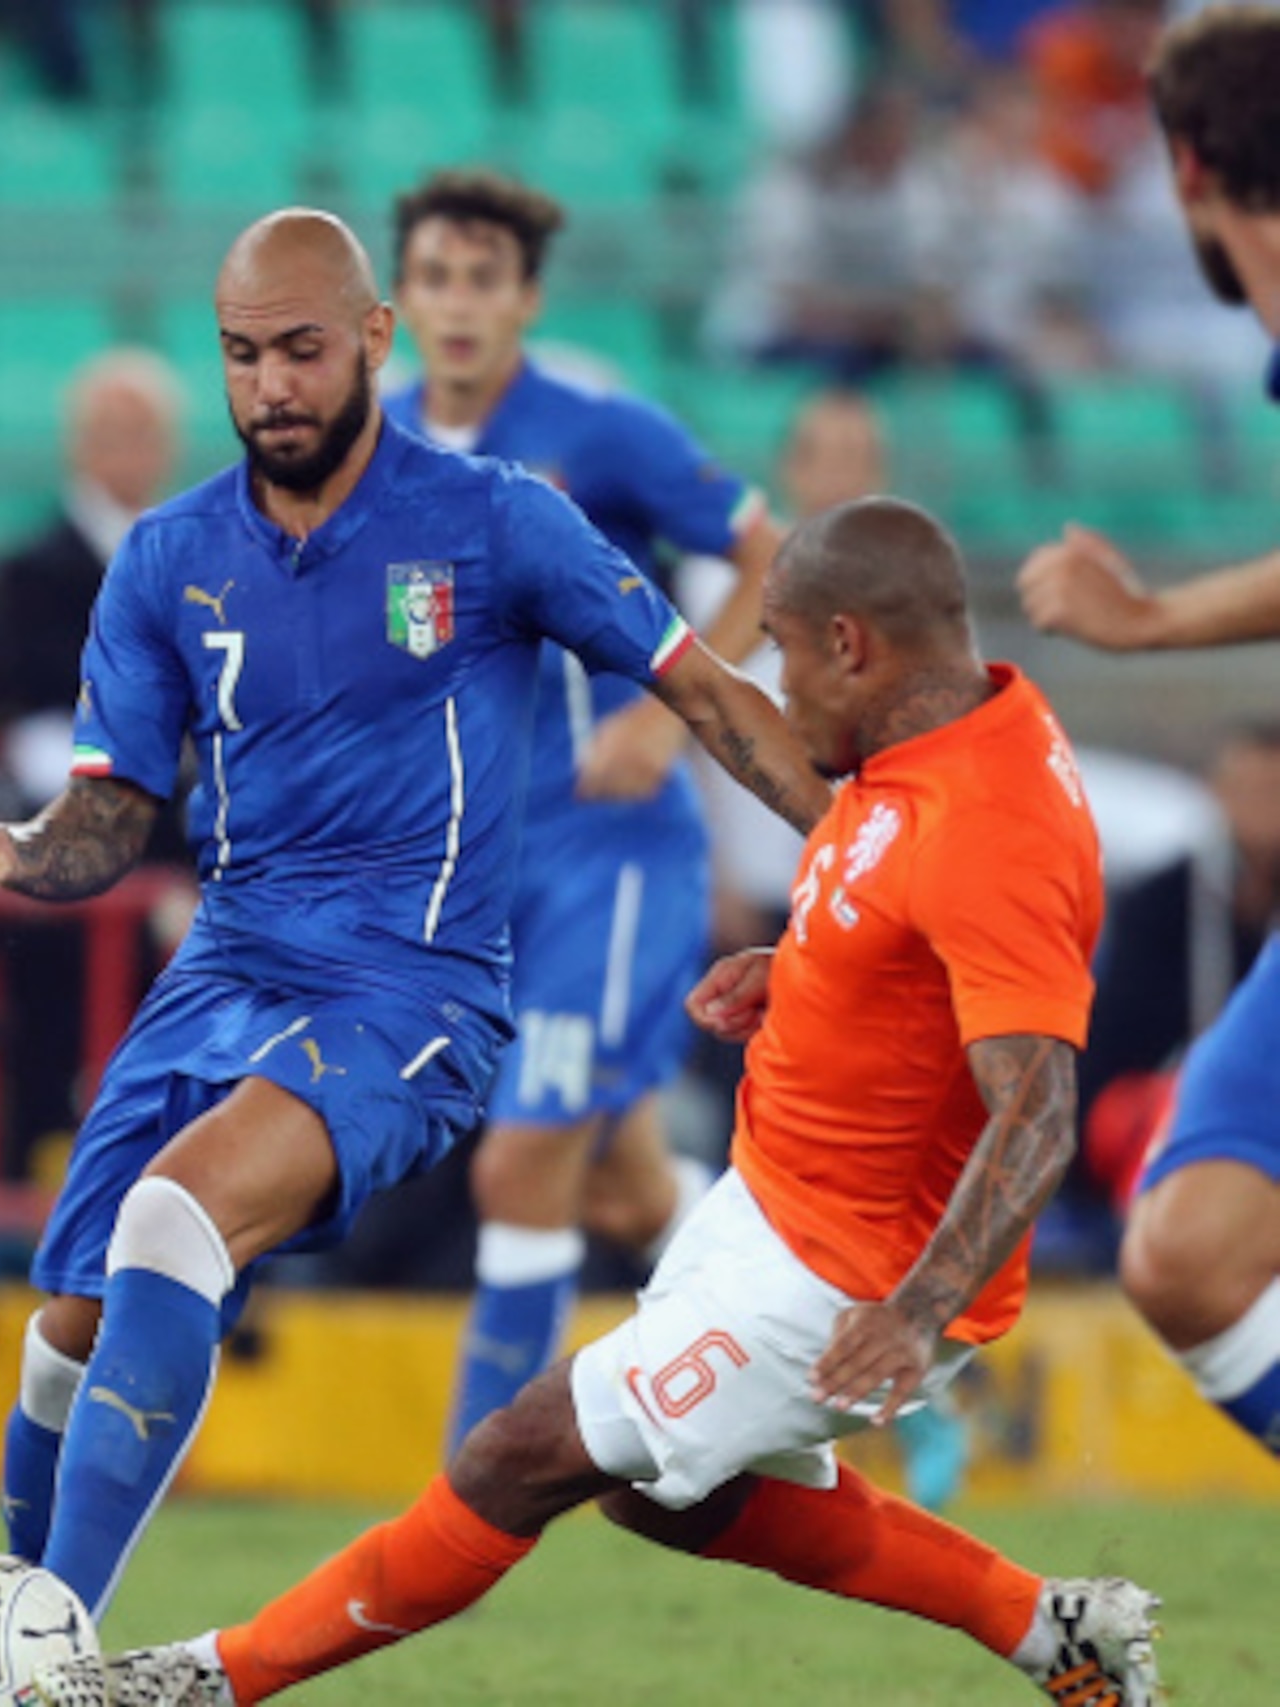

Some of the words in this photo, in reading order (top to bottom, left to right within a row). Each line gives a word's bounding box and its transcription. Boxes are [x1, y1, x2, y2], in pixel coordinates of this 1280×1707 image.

[201, 631, 243, 731] 7
[519, 1011, 592, 1111] 14
[651, 1329, 749, 1418] 6
